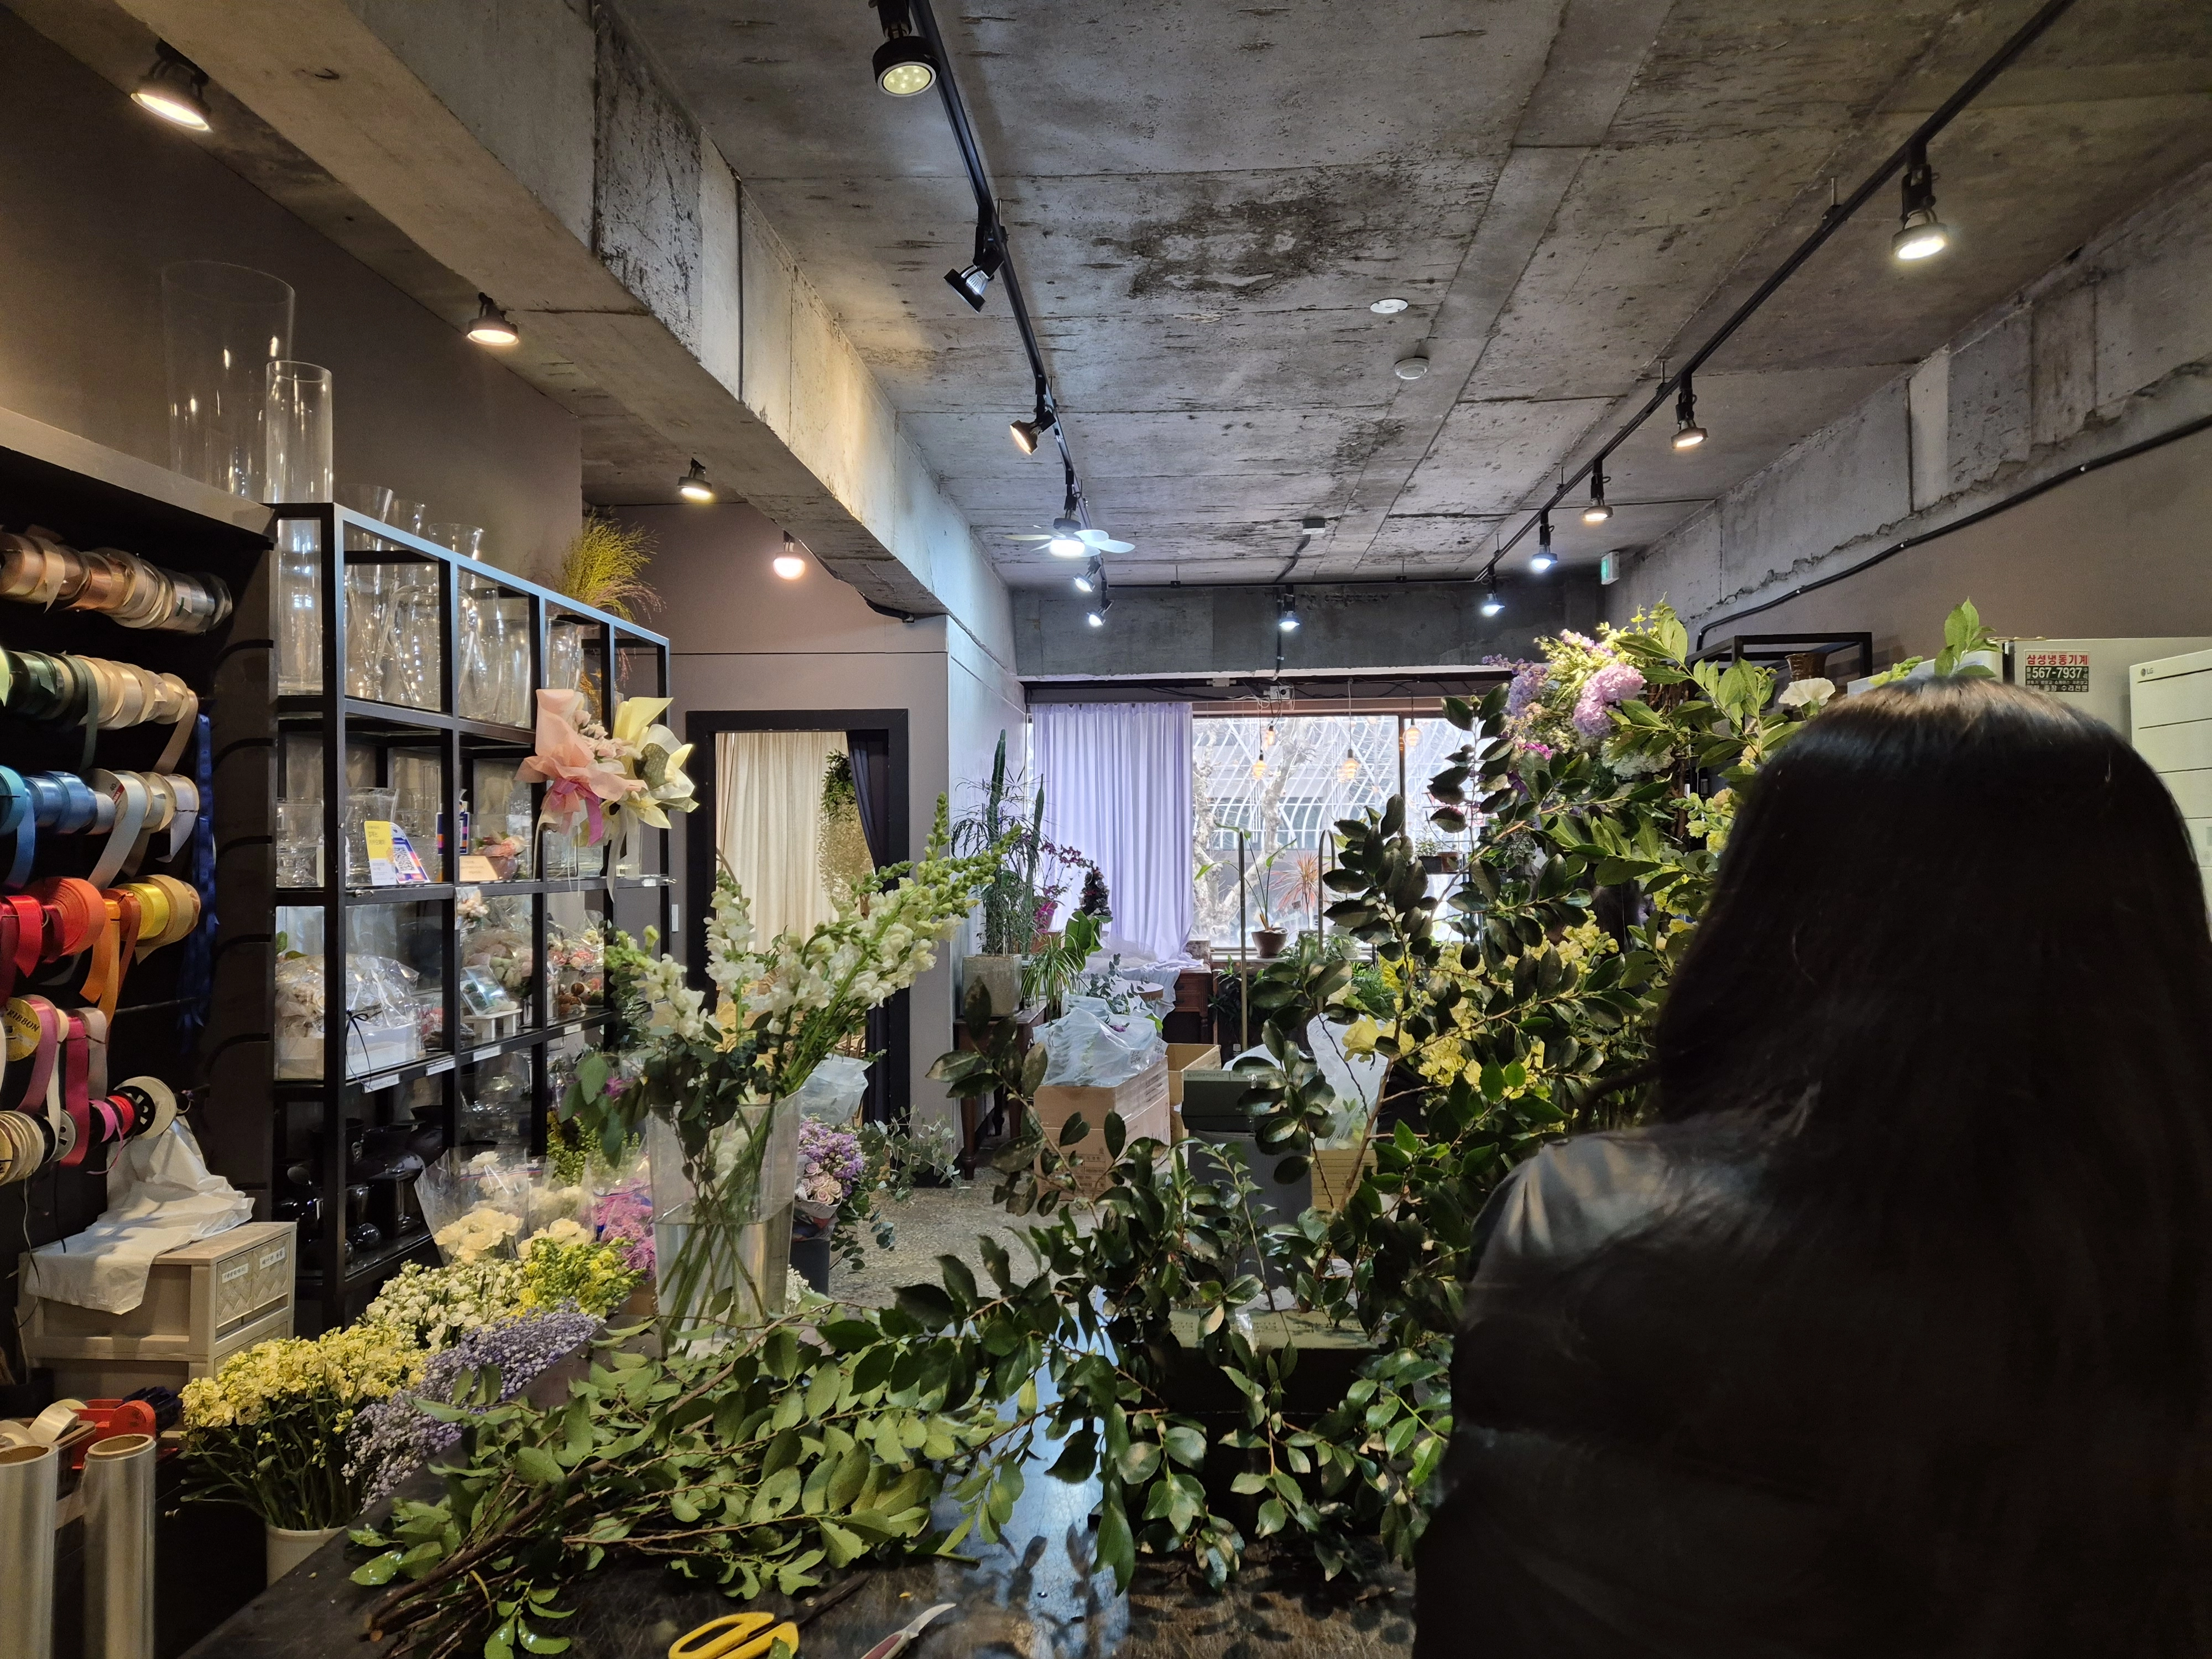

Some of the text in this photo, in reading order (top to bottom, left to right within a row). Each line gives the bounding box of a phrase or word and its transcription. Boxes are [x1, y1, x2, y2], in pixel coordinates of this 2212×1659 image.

[2027, 654, 2088, 665] 삼성냉동기계
[2032, 667, 2083, 679] 567-7937
[7, 1010, 39, 1032] RIBBON
